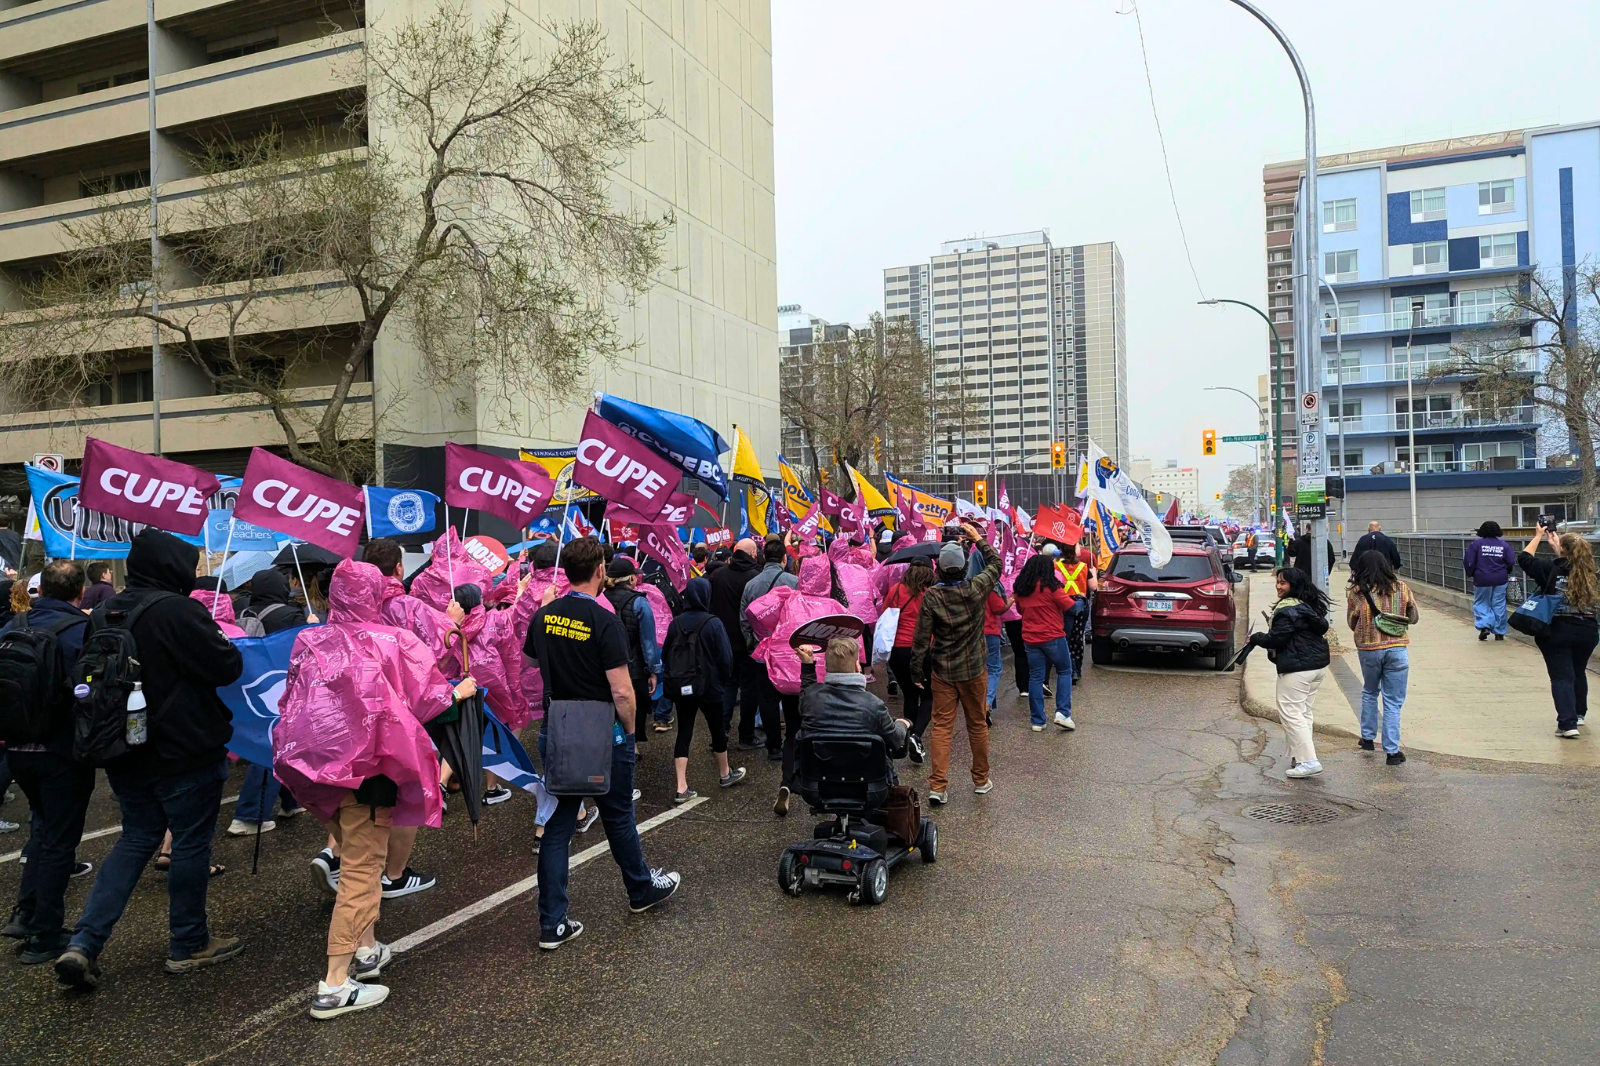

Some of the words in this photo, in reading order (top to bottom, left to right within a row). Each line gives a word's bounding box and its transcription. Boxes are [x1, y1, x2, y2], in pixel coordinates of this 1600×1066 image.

[576, 438, 668, 500] CUPE
[697, 459, 721, 481] BC
[100, 468, 204, 516] CUPE
[459, 466, 542, 514] CUPE
[252, 479, 361, 537] CUPE
[214, 522, 256, 531] Caholic
[232, 530, 272, 538] eachers
[706, 532, 720, 544] NO
[464, 538, 490, 560] NO
[480, 556, 498, 572] TIER
[486, 551, 504, 567] TWO
[545, 624, 568, 637] FIER
[799, 622, 836, 638] NO
[834, 626, 860, 636] TWO
